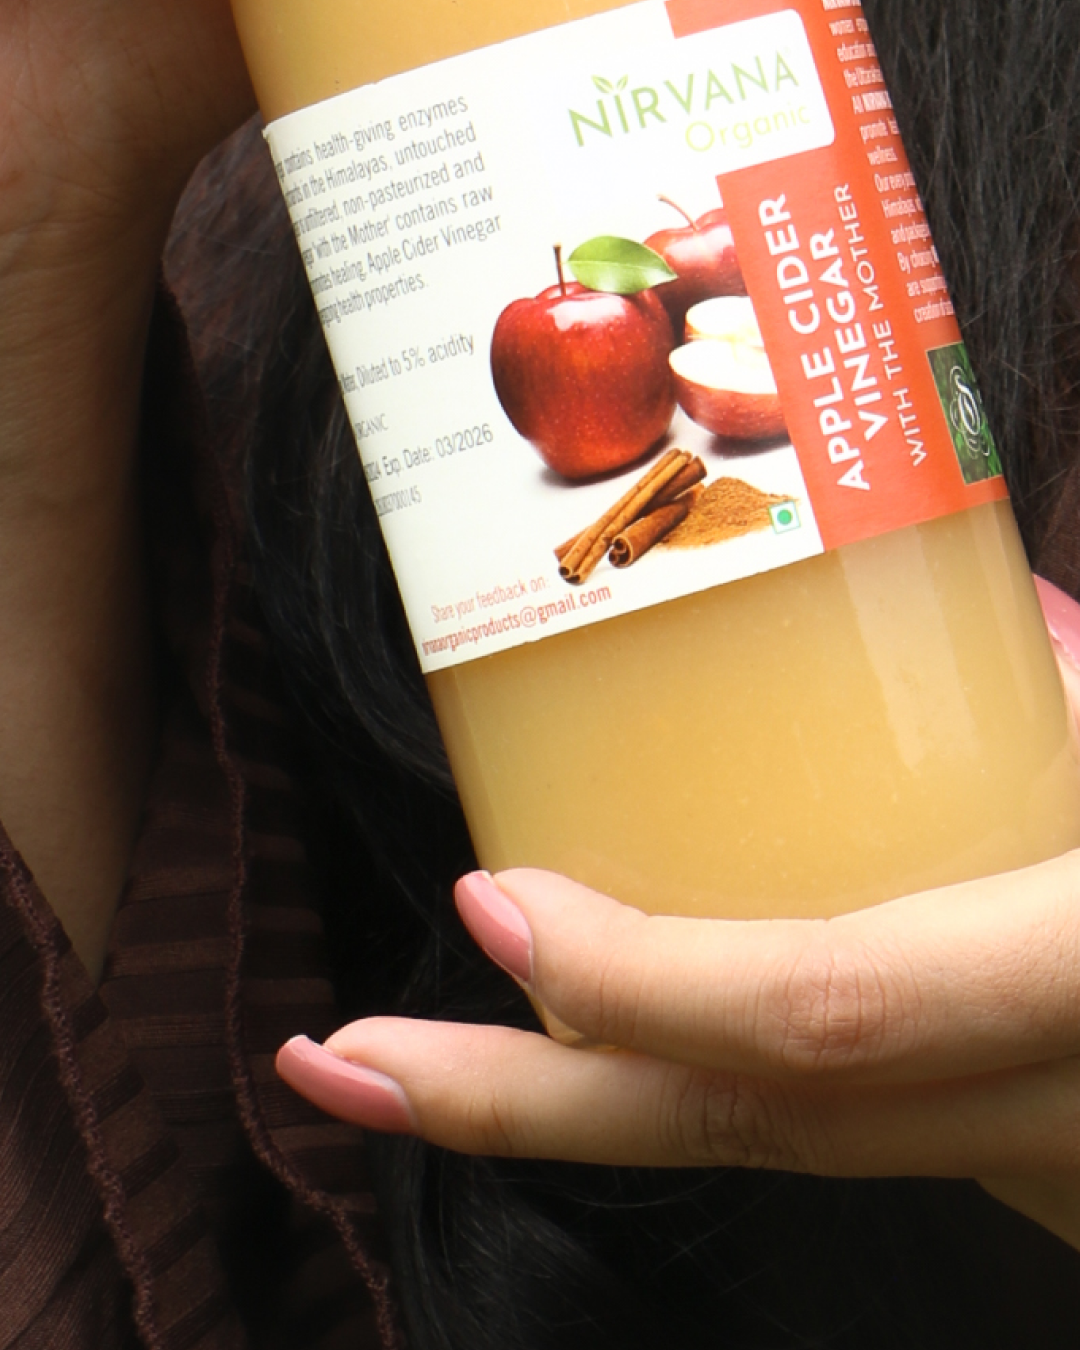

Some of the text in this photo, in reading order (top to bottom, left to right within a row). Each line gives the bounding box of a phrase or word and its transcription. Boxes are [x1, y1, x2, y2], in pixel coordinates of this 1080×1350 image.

[313, 119, 395, 162] health-giving
[398, 96, 468, 132] enzymes
[567, 51, 799, 147] NIRVANA
[685, 102, 811, 152] Organic
[394, 121, 477, 166] untouched
[343, 162, 450, 216] non-pasteurized
[453, 151, 486, 178] and
[395, 196, 458, 232] contains
[462, 185, 493, 209] raw
[366, 247, 402, 277] Apple
[401, 233, 440, 261] Cider
[440, 214, 502, 248] Vinegar
[388, 354, 402, 377] to
[401, 346, 426, 372] 5%
[427, 333, 475, 364] acidity
[758, 192, 871, 491] APPLE CIDER
[809, 227, 889, 441] VINEGAR
[834, 182, 928, 467] WITH THE MOTHER
[402, 447, 435, 470] Date:
[435, 422, 494, 460] 03/2026
[455, 596, 475, 621] your
[476, 578, 528, 609] feedback
